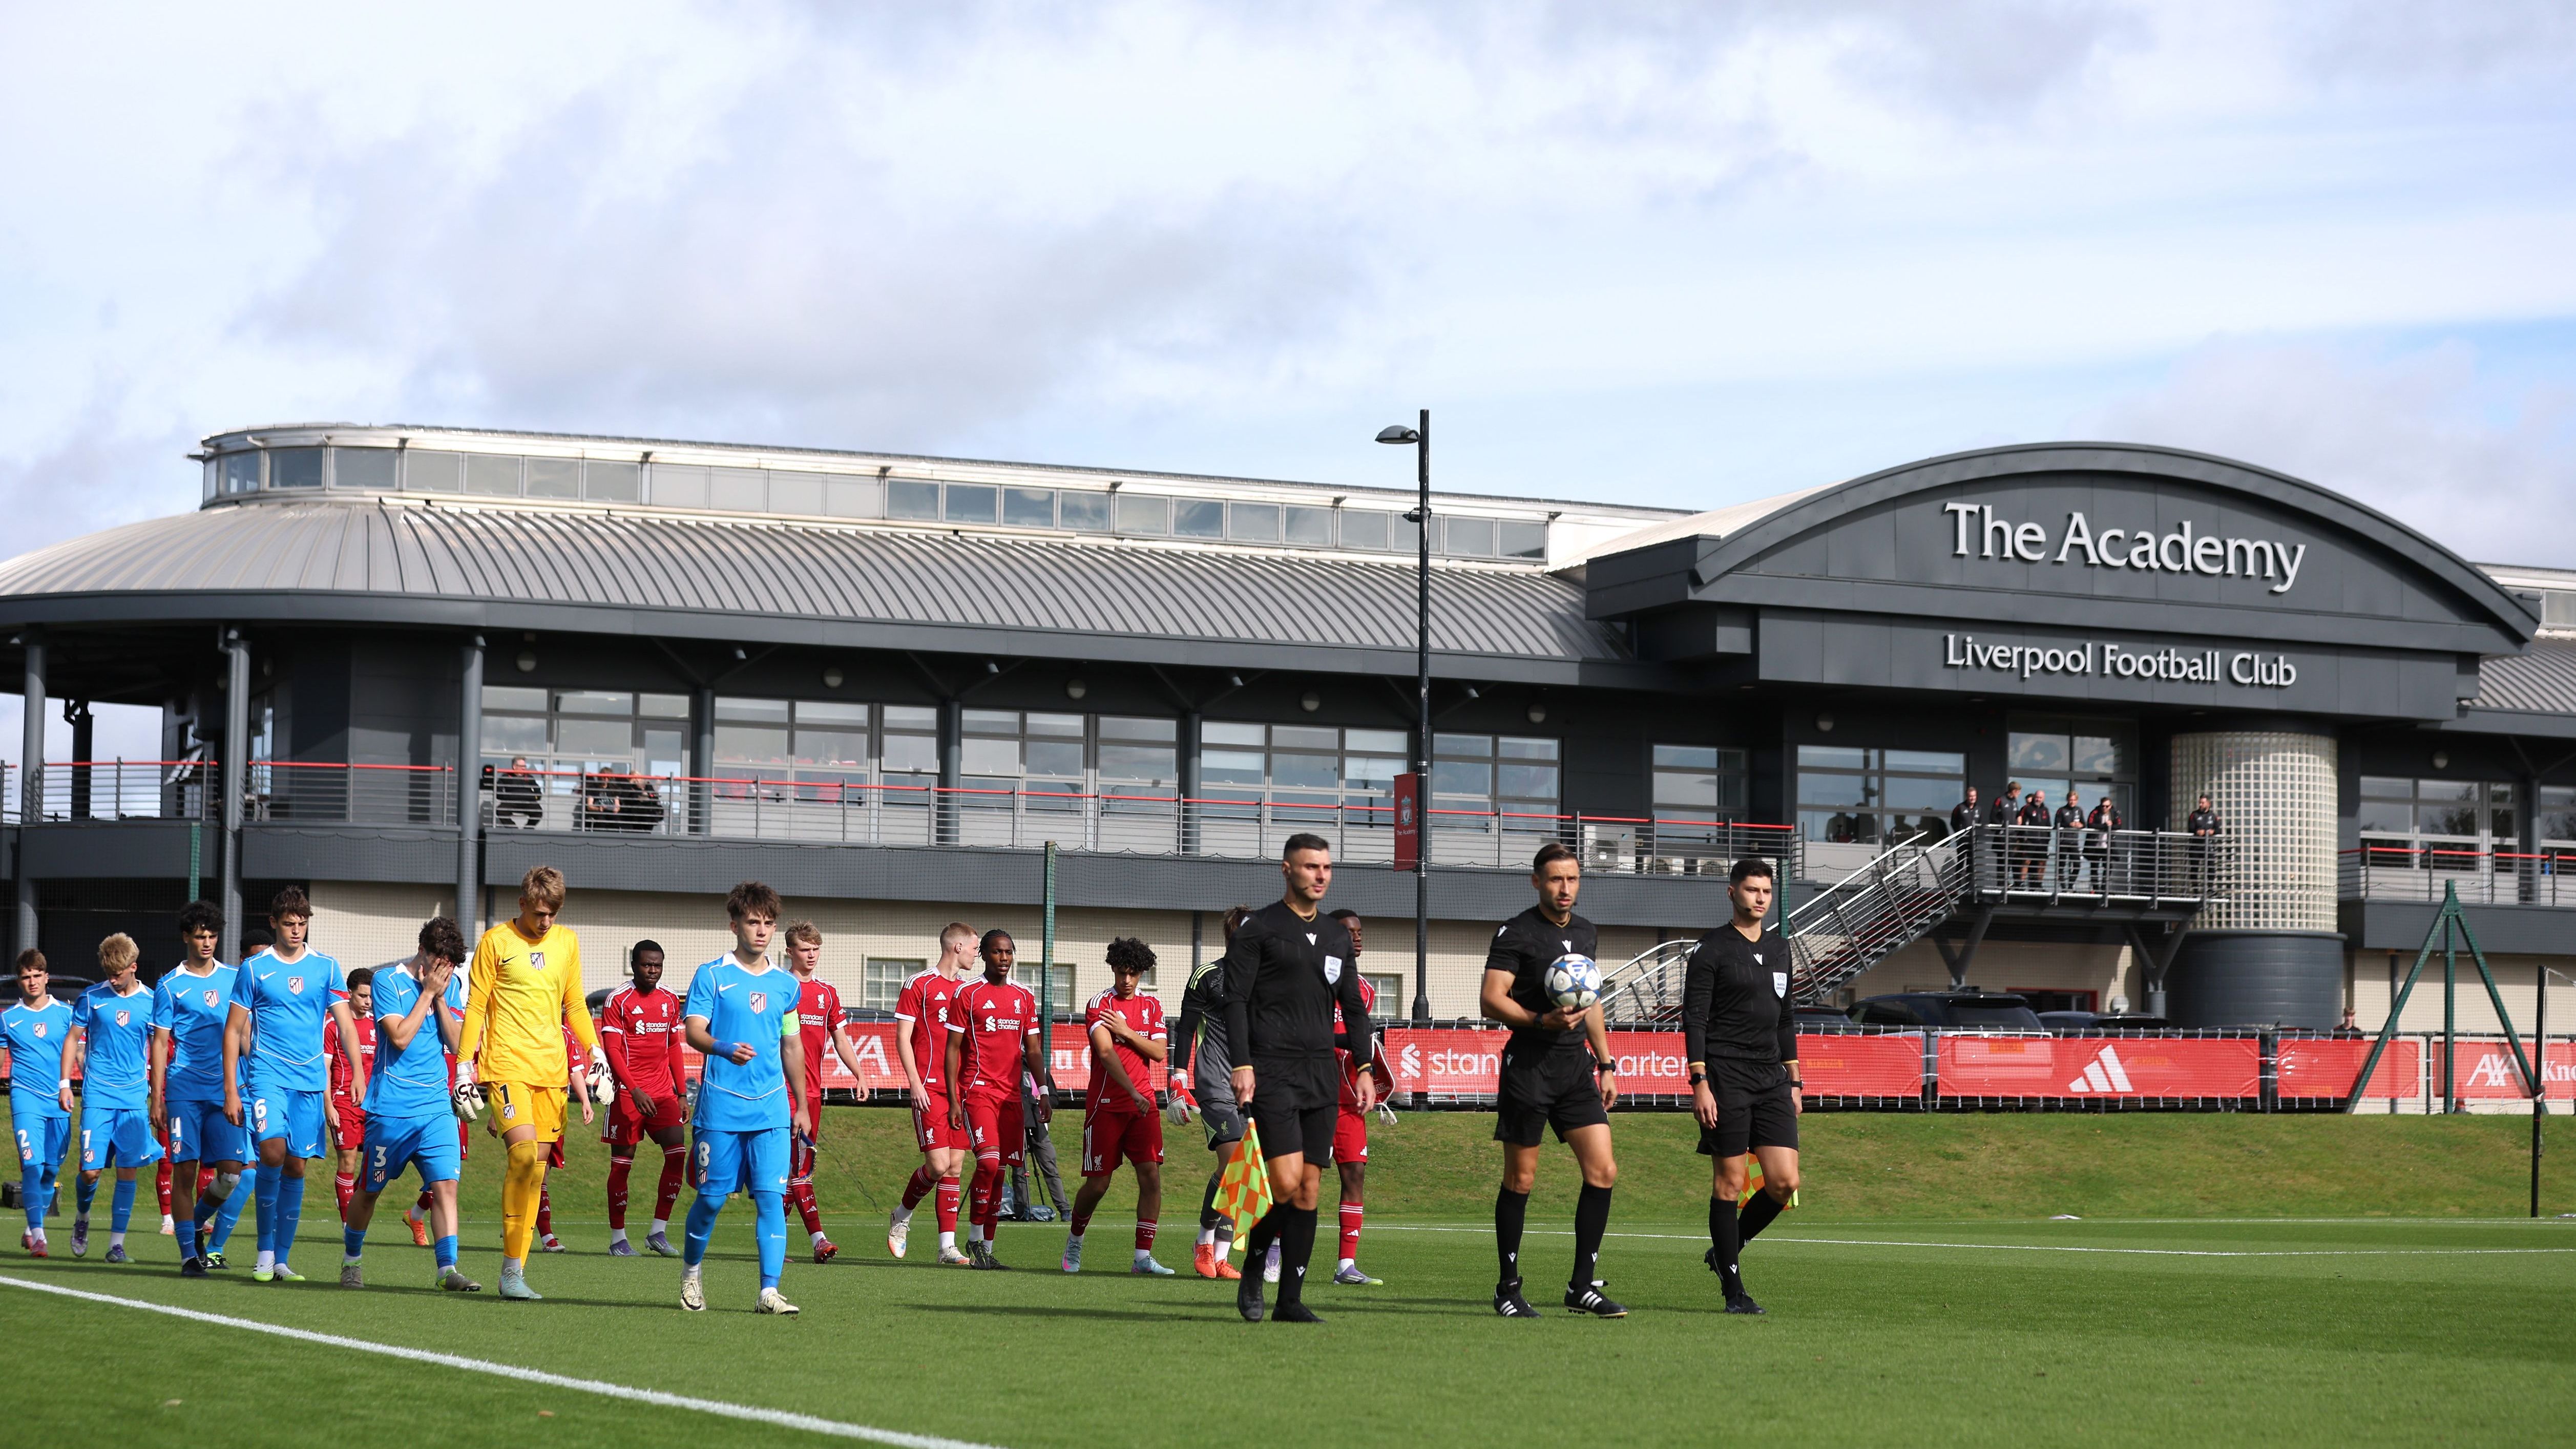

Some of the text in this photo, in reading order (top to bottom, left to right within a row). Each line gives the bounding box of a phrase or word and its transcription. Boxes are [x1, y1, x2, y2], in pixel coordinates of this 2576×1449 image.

[1945, 502, 2306, 593] The Academy
[1946, 634, 2297, 686] Liverpool Football Club
[2465, 1053, 2526, 1087] AXA
[499, 1083, 510, 1105] 1
[254, 1098, 267, 1119] 6
[17, 1129, 30, 1148] 2
[170, 1117, 182, 1138] 4
[374, 1145, 387, 1167] 3
[698, 1141, 710, 1167] 8
[801, 1194, 815, 1203] LFC
